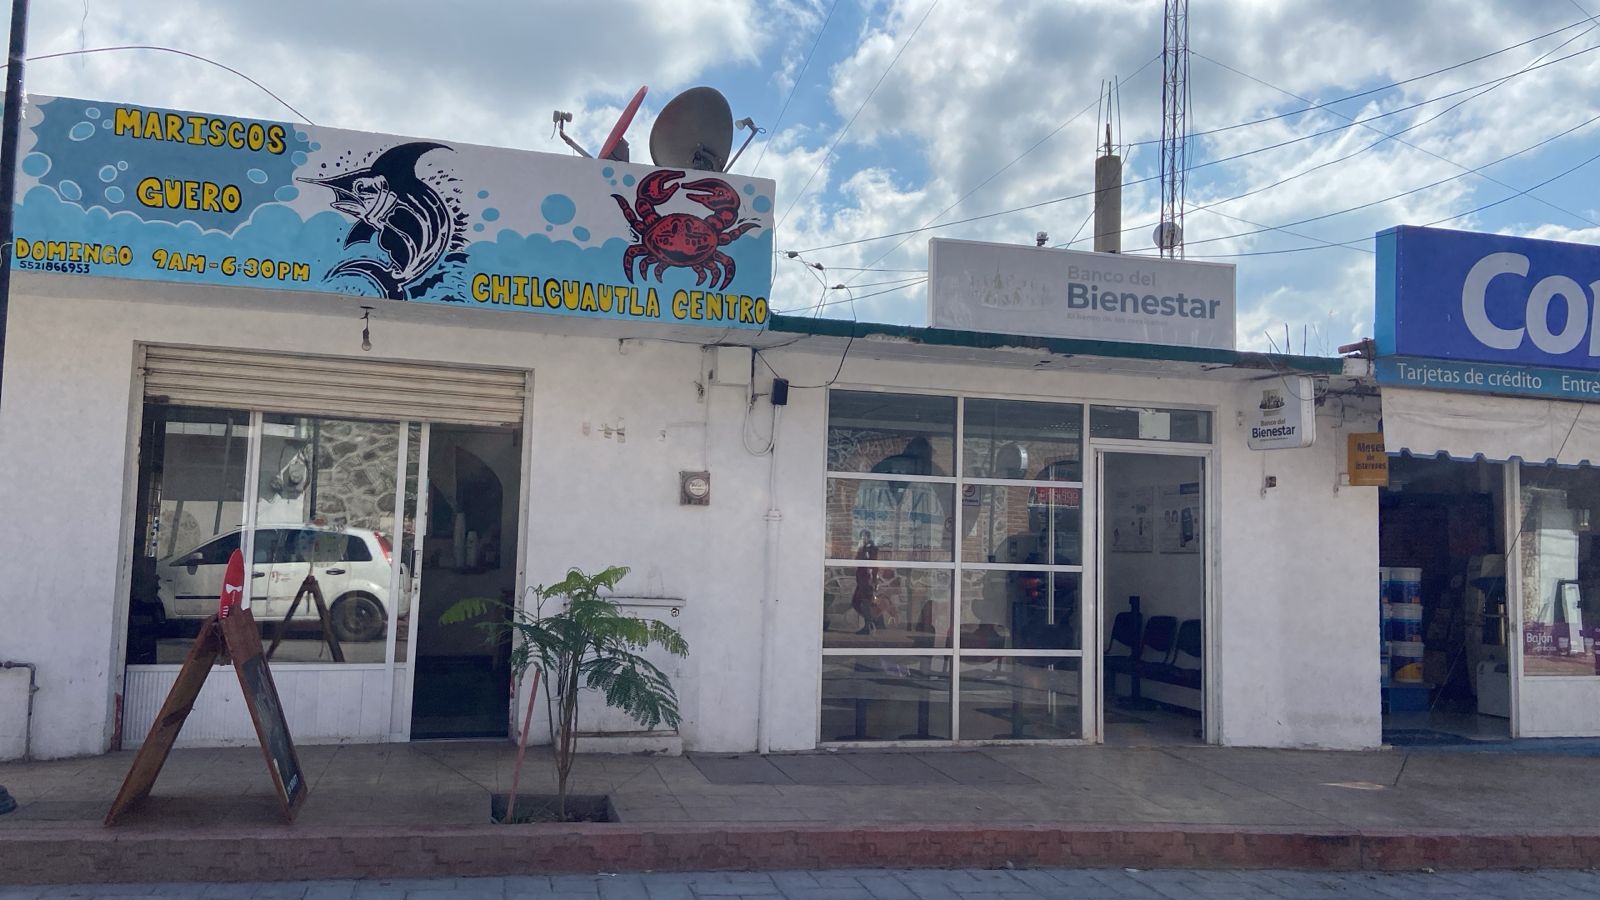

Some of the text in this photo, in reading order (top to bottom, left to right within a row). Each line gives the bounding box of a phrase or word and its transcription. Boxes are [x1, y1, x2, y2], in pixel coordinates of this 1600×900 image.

[115, 107, 286, 154] MARISCOS
[15, 238, 133, 265] DOMINGO
[19, 260, 90, 274] 5521866953
[1068, 265, 1156, 287] Banco del
[472, 273, 768, 325] CHILCUAUTLA CENTRO
[1067, 283, 1221, 320] Bienestar
[1462, 252, 1600, 357] Co
[1397, 363, 1600, 394] Tarjetas de crédito Entre
[1252, 426, 1296, 439] Bienestar
